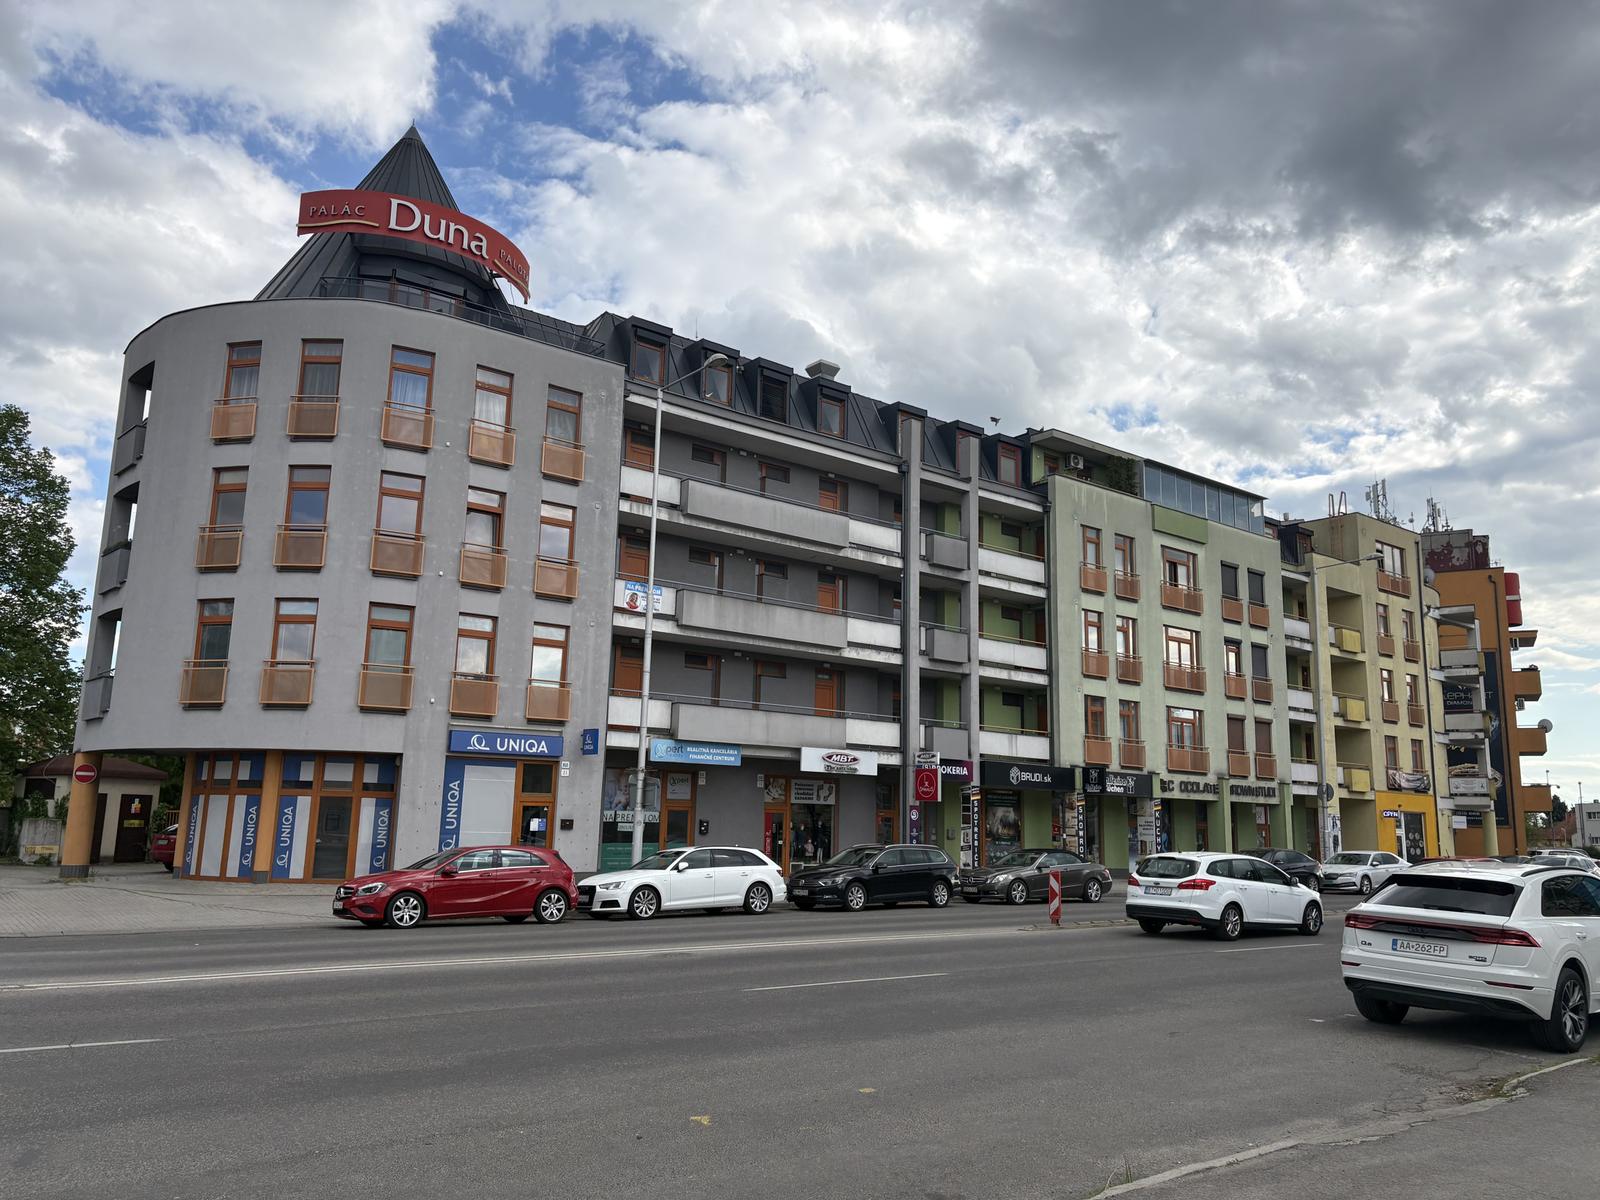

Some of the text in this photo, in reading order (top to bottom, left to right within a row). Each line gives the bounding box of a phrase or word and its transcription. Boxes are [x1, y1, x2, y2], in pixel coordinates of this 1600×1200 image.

[308, 201, 366, 217] PALÁC
[387, 197, 489, 259] Duna
[496, 737, 549, 754] UNIQA
[188, 804, 199, 844] UNIQA
[445, 780, 461, 829] UNIQA
[245, 805, 258, 846] UNIQA
[280, 806, 294, 847] UNIQA
[376, 808, 390, 848] UNIQA
